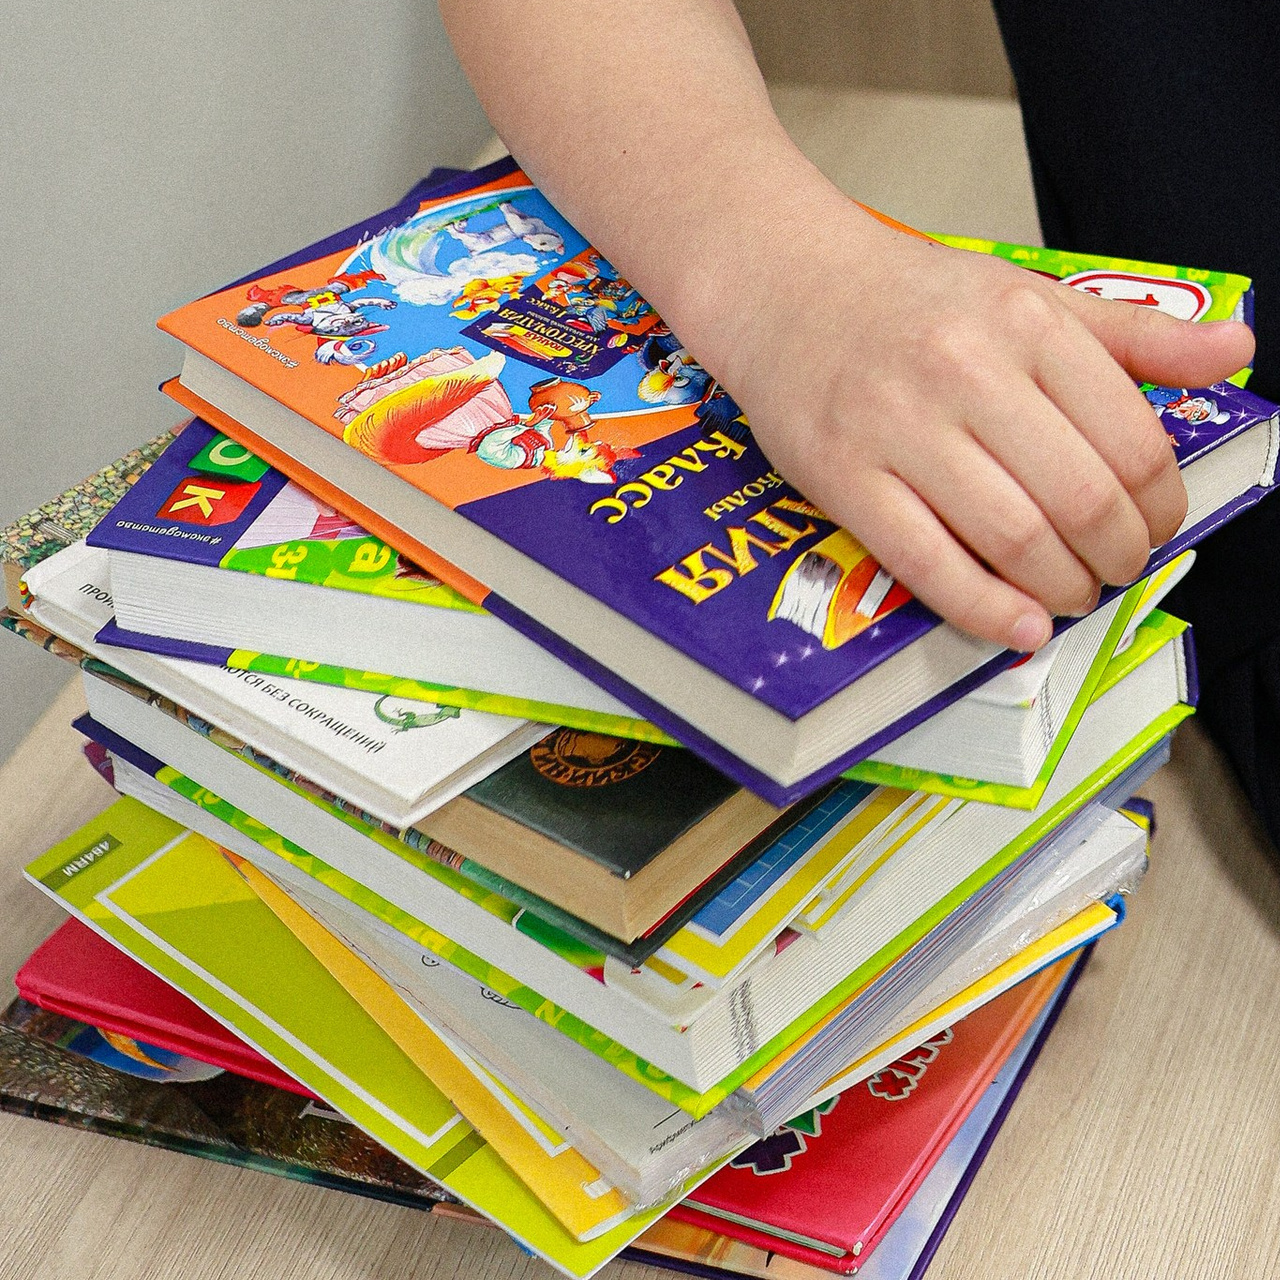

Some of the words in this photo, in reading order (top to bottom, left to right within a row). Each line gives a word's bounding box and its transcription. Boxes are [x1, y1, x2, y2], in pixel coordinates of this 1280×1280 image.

[498, 306, 604, 356] ХРЕСТОМАТИЯ
[523, 331, 565, 352] ПОЛНАЯ
[261, 679, 291, 702] БЕЗ
[288, 698, 387, 754] СОКРАЩЕНИЙ
